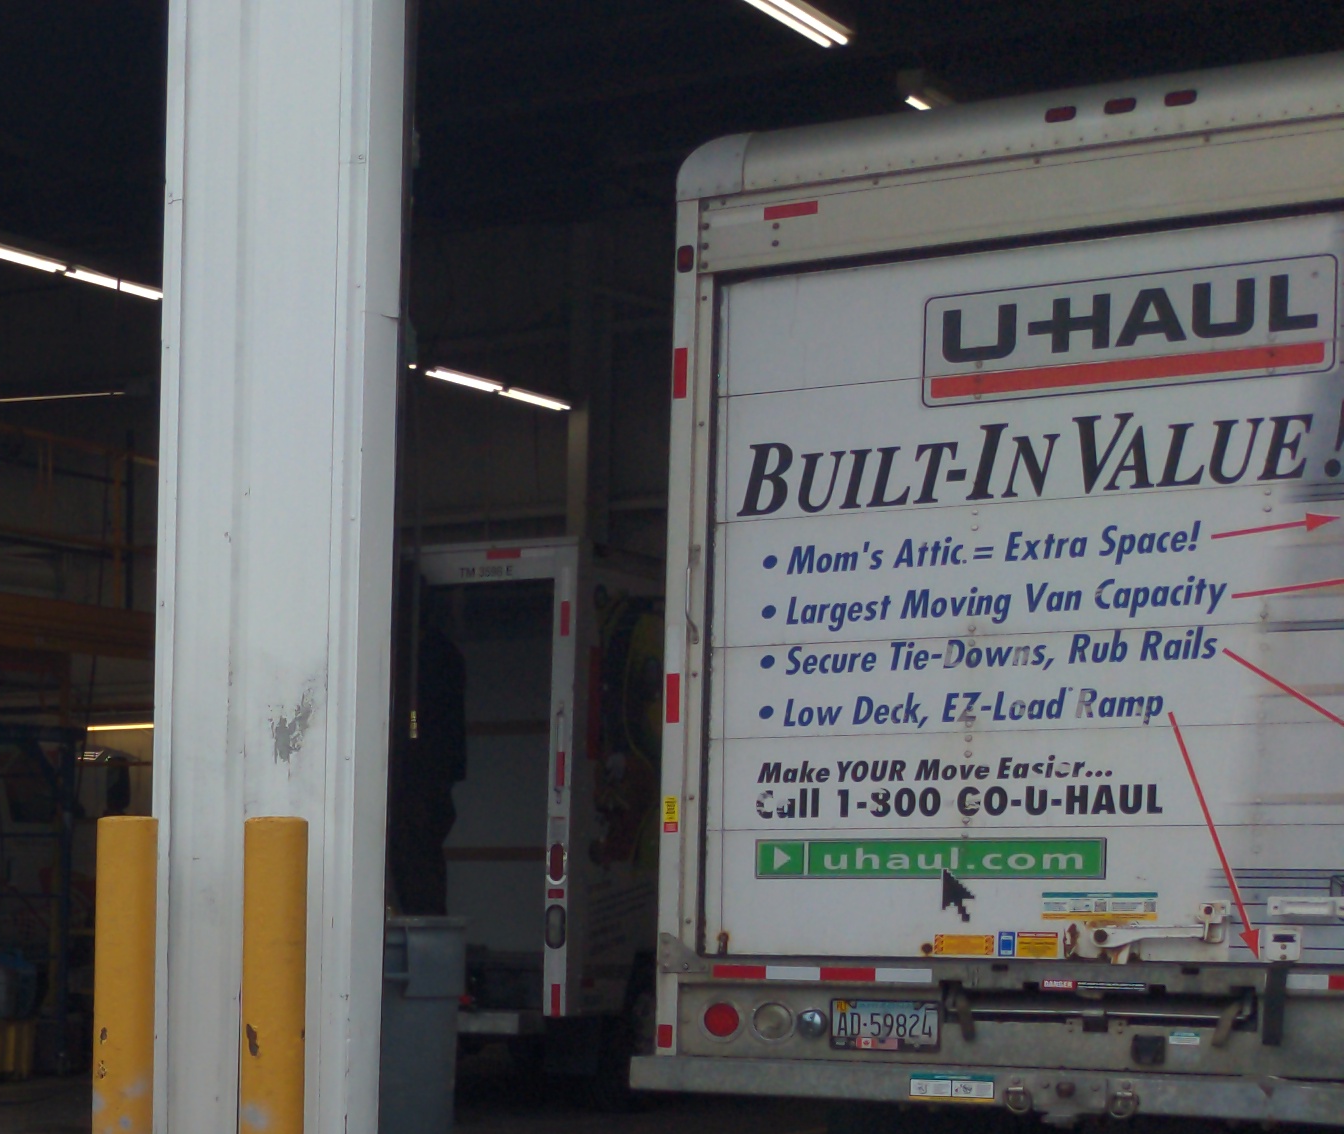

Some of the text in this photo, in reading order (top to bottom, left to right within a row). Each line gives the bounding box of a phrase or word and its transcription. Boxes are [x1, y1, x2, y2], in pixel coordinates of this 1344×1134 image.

[942, 273, 1318, 363] U-HAUL
[736, 422, 1061, 517] BUILT-IN
[786, 541, 884, 575] Mom's
[1004, 531, 1088, 562] Extra
[1098, 520, 1202, 565] Space!
[459, 567, 475, 578] TM
[786, 575, 1228, 632] Largest Moving Van Capacity
[785, 626, 1218, 675] Secure Tie-Downs, Rub Rails
[783, 698, 843, 727] Low
[852, 692, 929, 728] Deck,
[1074, 688, 1164, 725] Ramp
[757, 760, 831, 783] Make
[836, 759, 907, 782] YOUR
[914, 758, 990, 781] Move
[756, 787, 820, 819] Call
[837, 786, 942, 818] 1-800
[823, 847, 1084, 870] uhaul.com
[1043, 980, 1073, 989] DANGER
